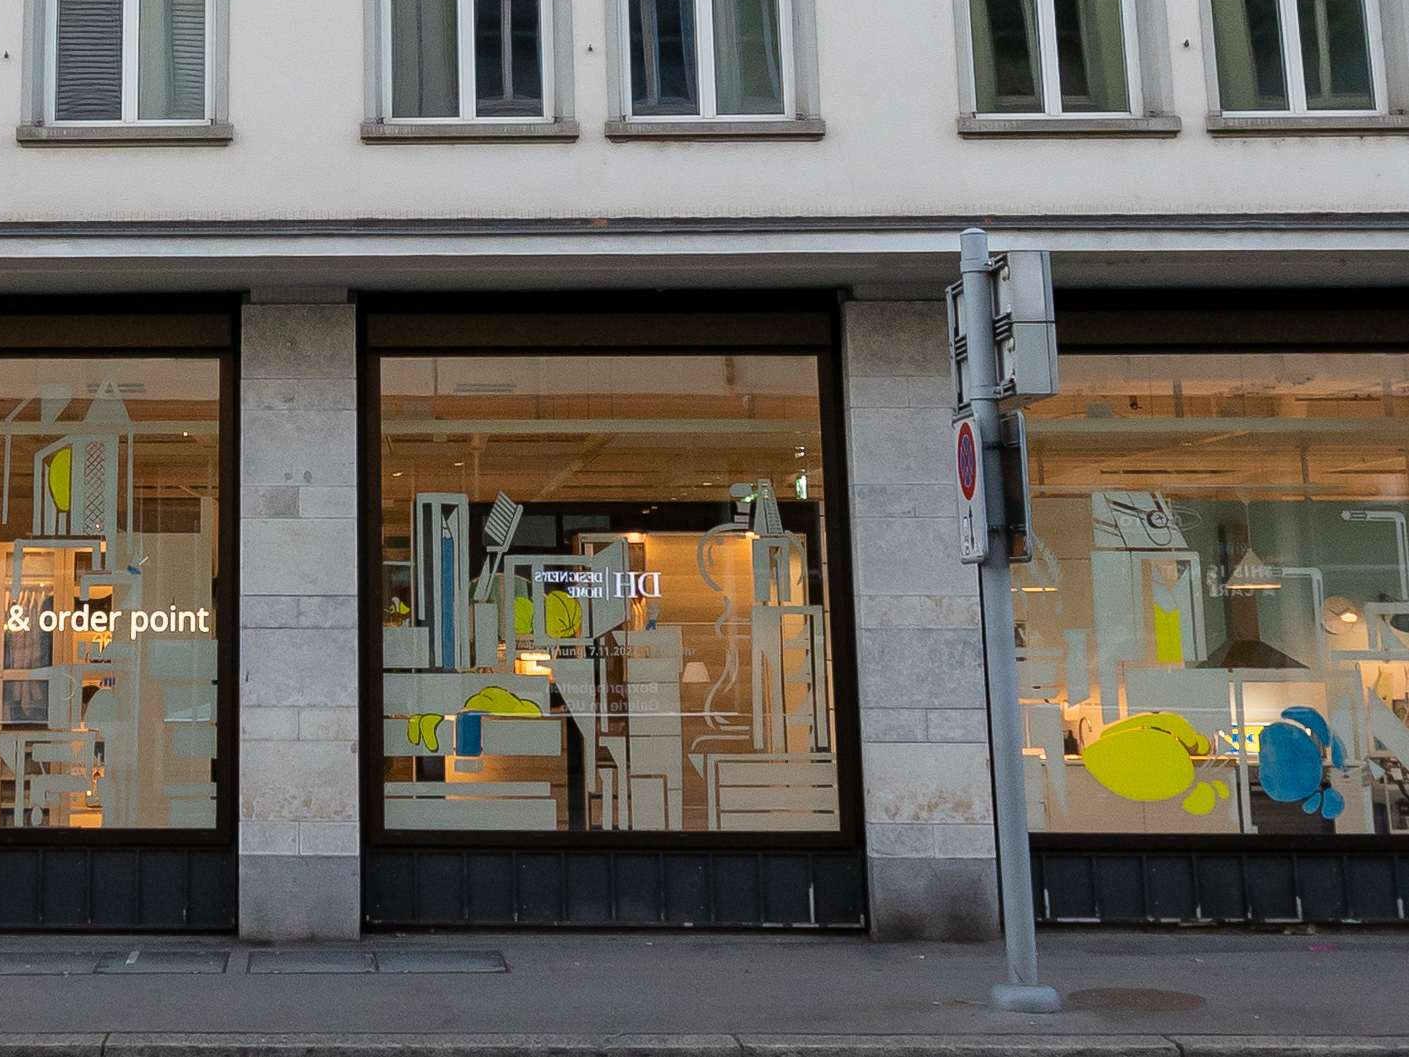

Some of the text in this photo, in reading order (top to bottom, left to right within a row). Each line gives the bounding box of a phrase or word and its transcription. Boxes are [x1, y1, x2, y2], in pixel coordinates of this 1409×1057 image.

[6, 604, 30, 632] &
[39, 603, 122, 632] order
[130, 604, 210, 641] point
